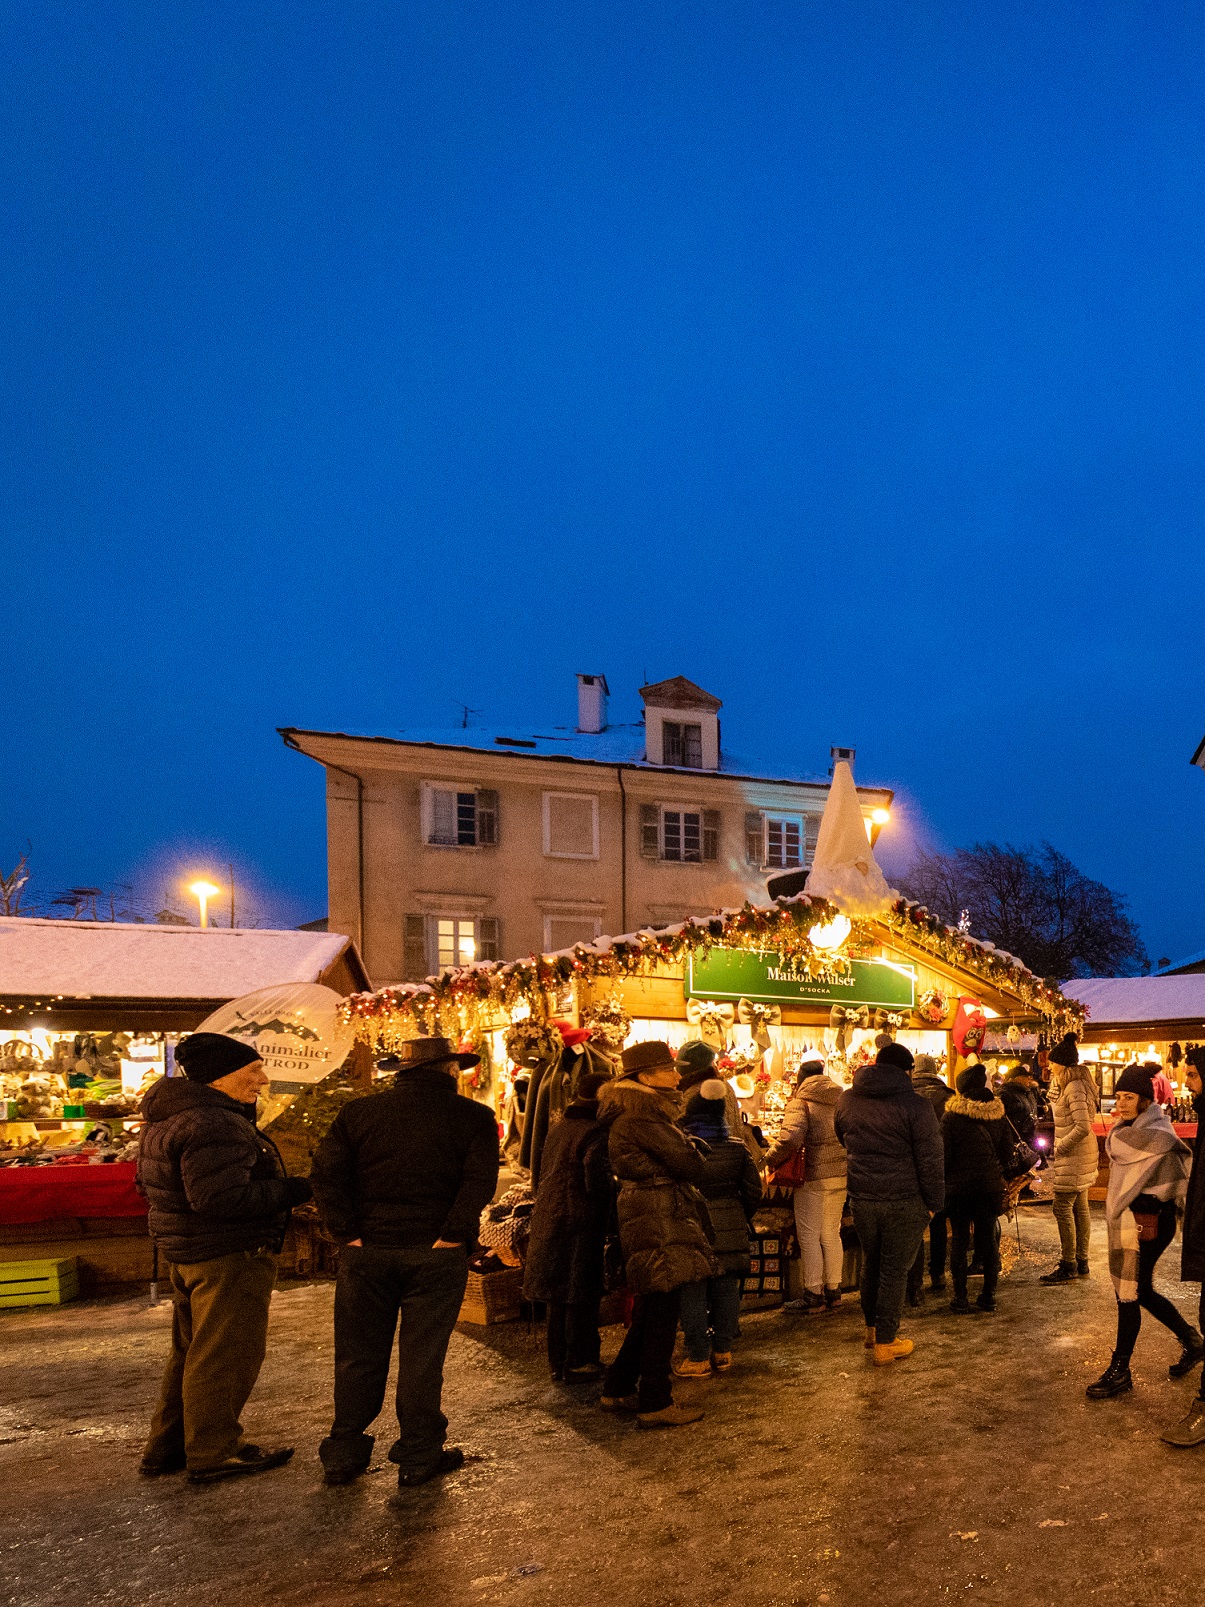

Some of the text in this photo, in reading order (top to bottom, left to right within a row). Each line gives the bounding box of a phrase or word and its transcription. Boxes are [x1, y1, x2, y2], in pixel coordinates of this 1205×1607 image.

[767, 966, 812, 983] Maison
[252, 1040, 332, 1059] Animalier
[264, 1058, 309, 1070] TROD
